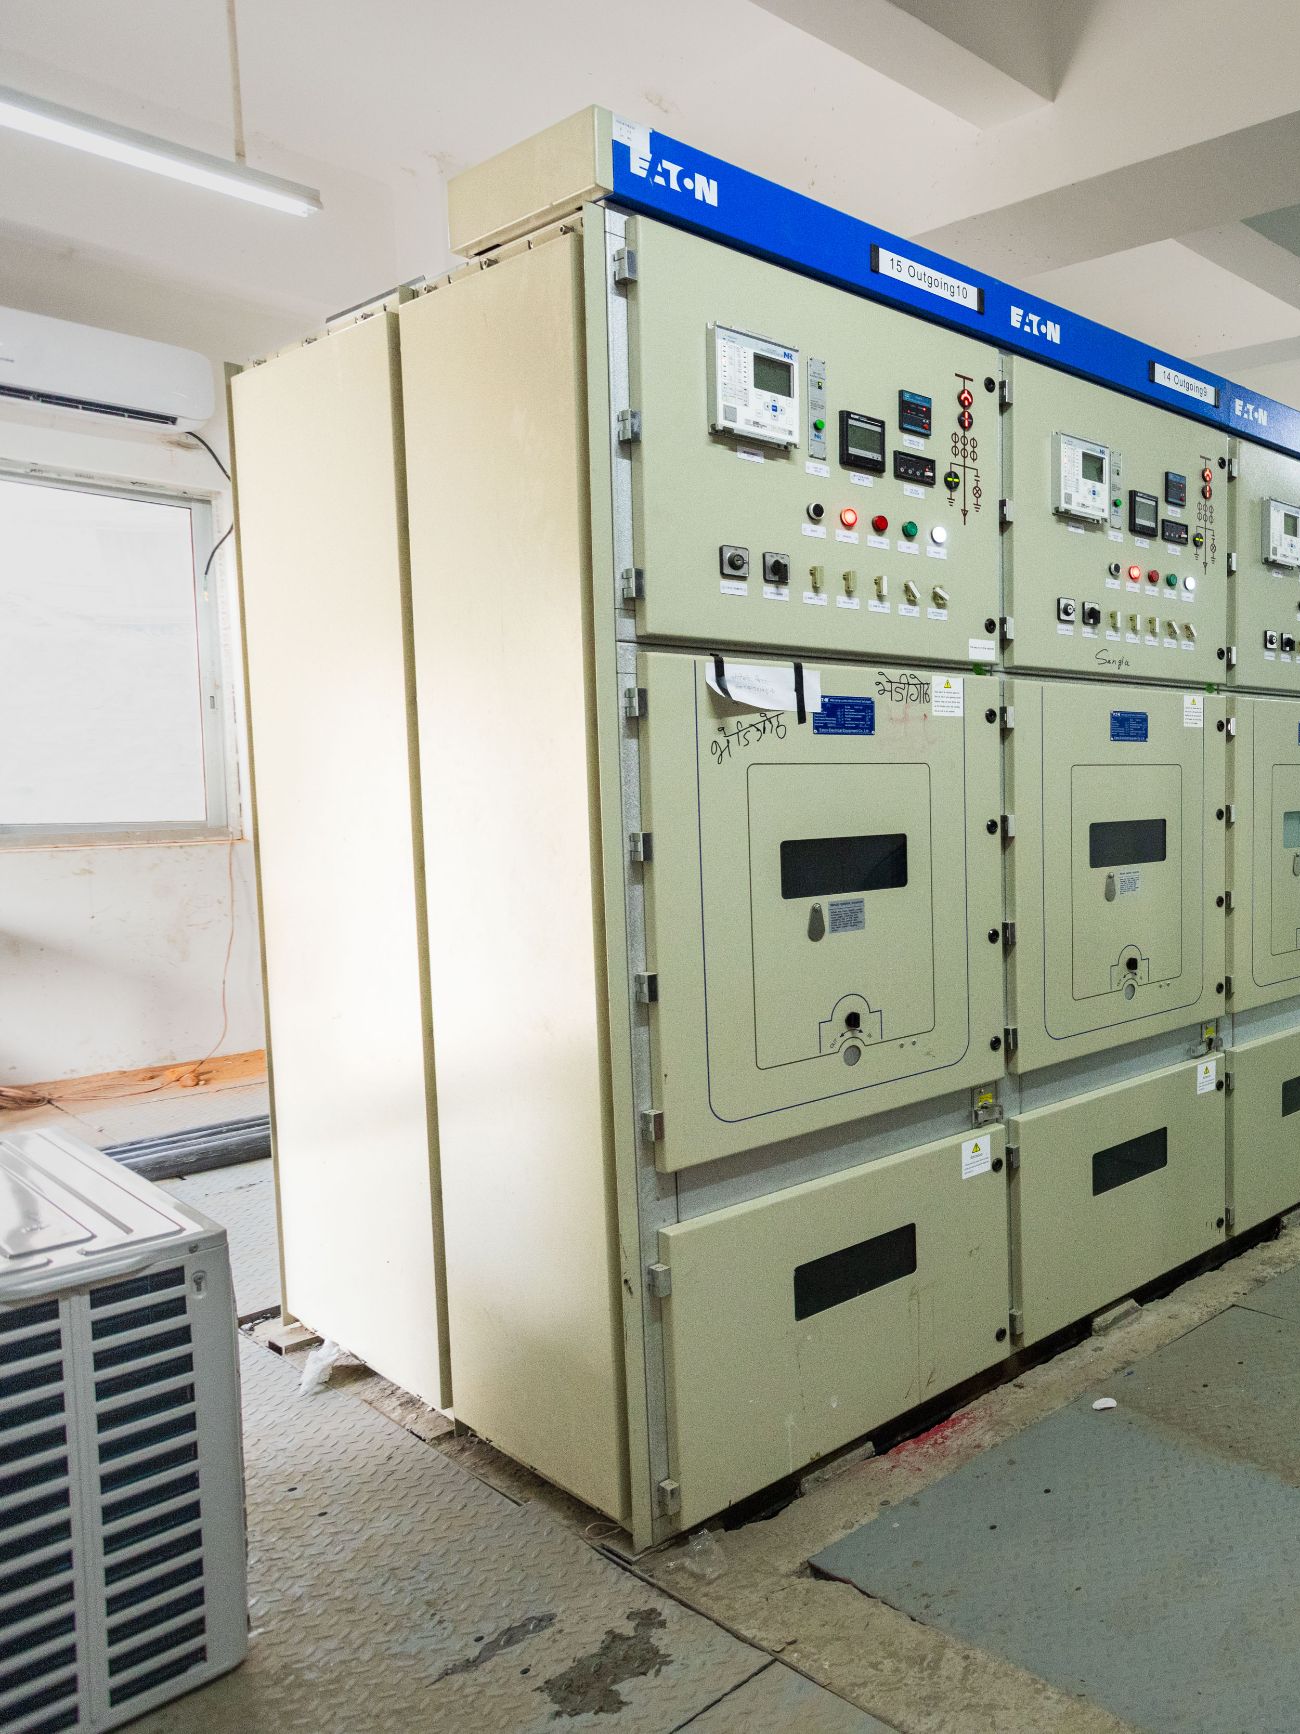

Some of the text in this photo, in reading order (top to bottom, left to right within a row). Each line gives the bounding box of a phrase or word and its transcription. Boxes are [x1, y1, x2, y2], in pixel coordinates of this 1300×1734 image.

[630, 152, 718, 207] EATON
[889, 257, 969, 300] 15 Outgoing10
[1010, 305, 1061, 345] EATON
[783, 351, 794, 361] NR
[1162, 370, 1171, 382] 14
[1234, 398, 1268, 427] EATON
